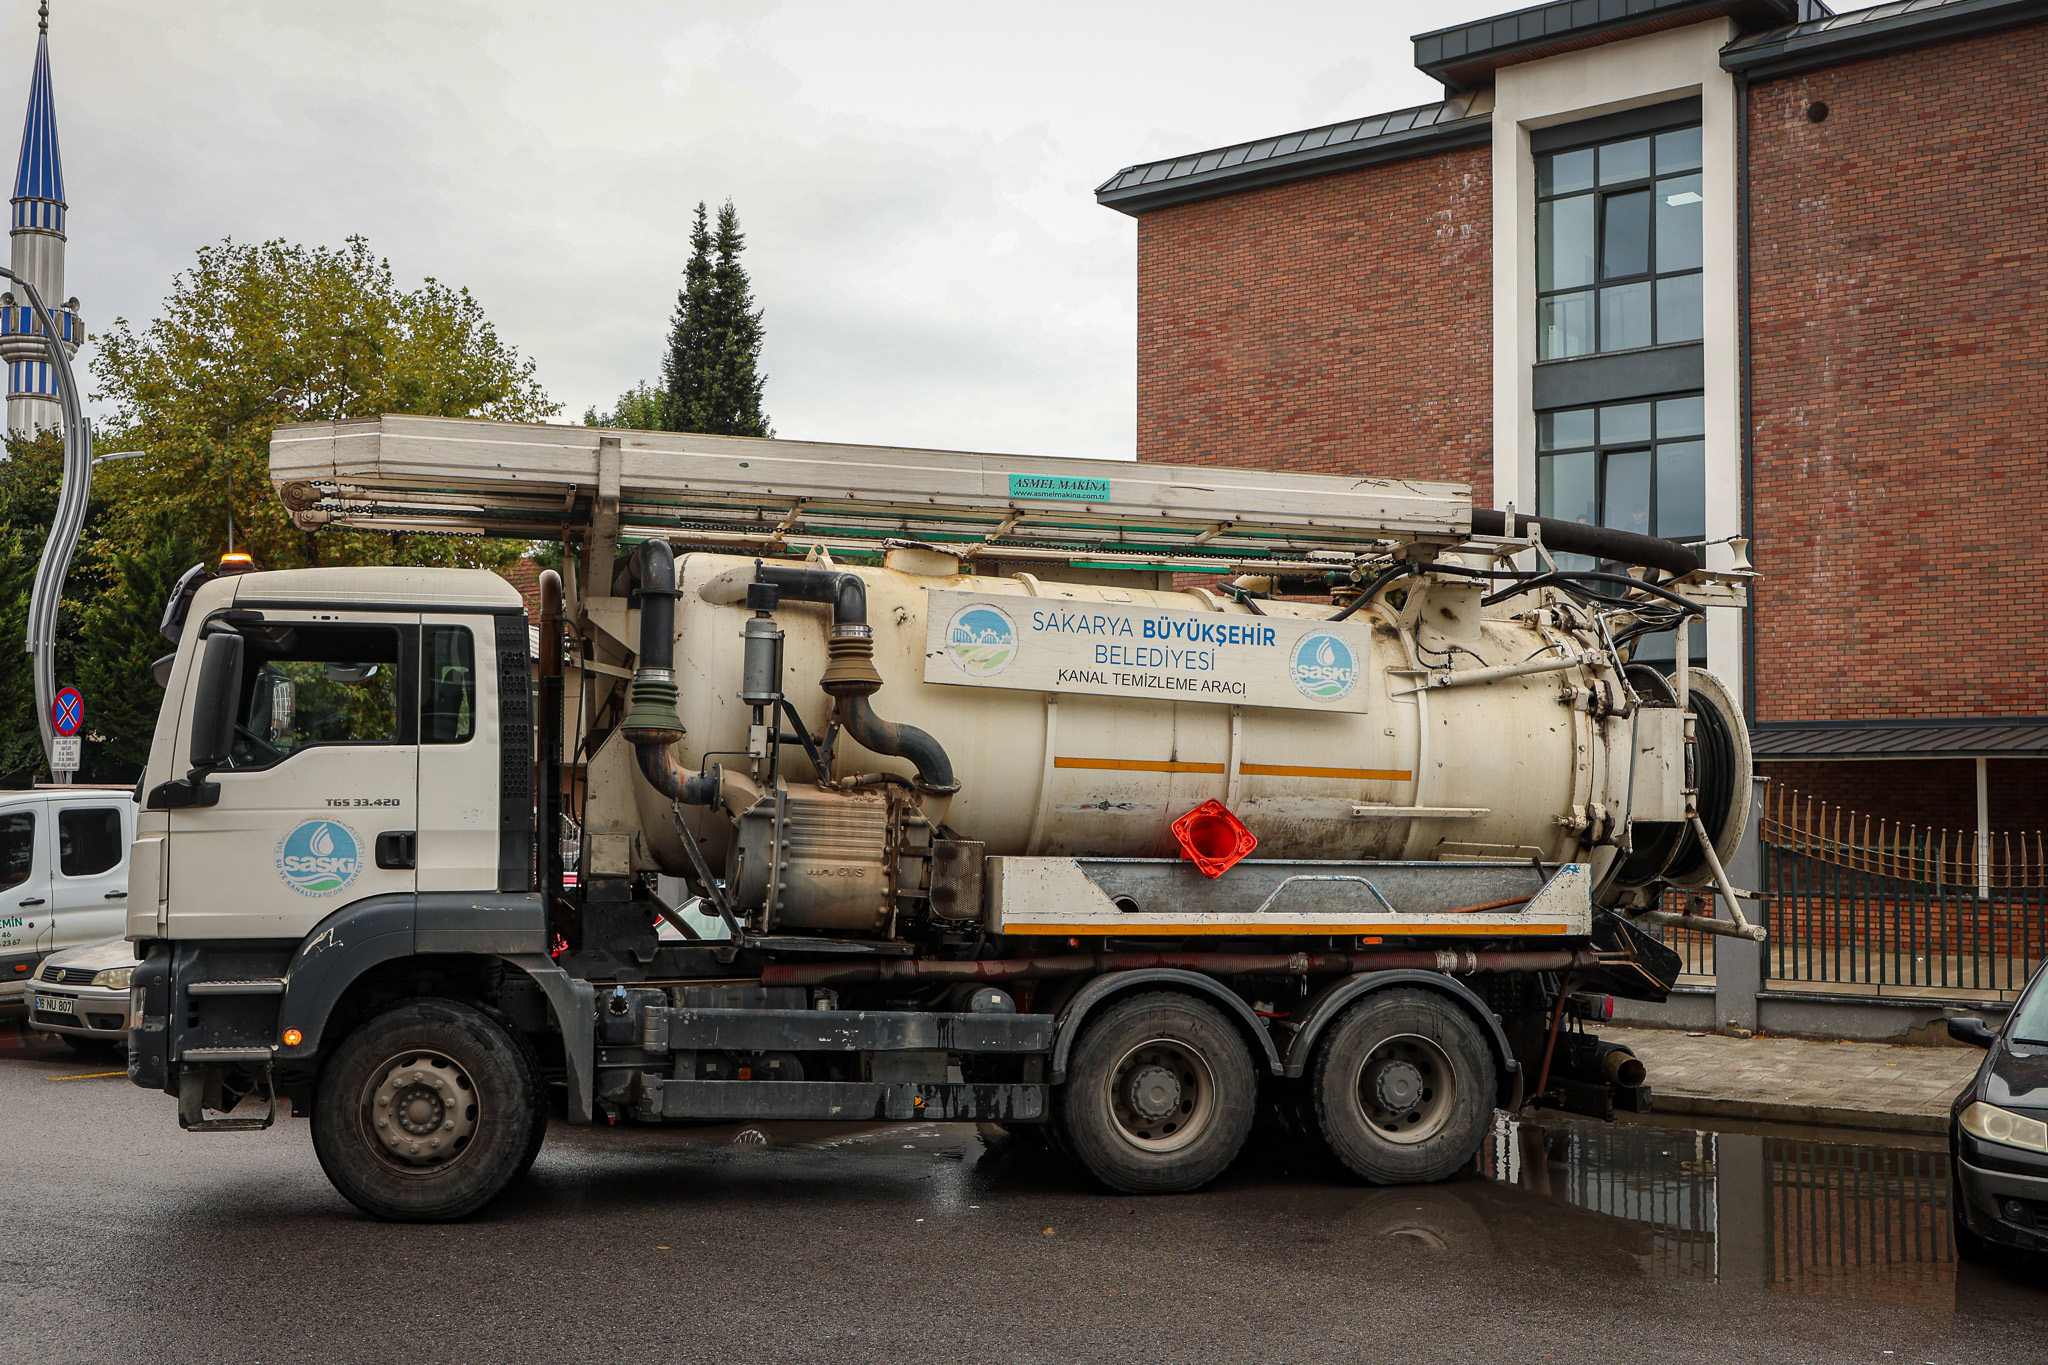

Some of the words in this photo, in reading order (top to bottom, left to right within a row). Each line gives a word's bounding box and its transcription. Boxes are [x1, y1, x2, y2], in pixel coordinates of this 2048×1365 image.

[1014, 478, 1055, 489] ASMEL
[1058, 479, 1106, 491] MAKİNA
[1013, 490, 1105, 500] www.asmelmakina.com.tr
[1032, 611, 1133, 637] SAKARYA
[1143, 616, 1276, 647] BÜYÜKŞEHİR
[1095, 644, 1215, 671] BELEDİYESİ
[1058, 669, 1108, 685] KANAL
[1112, 672, 1197, 691] TEMİZLEME
[1201, 680, 1246, 694] ARACI
[325, 798, 350, 807] TGS
[353, 798, 400, 807] 33.420
[275, 858, 283, 868] SU
[279, 870, 288, 880] VE
[343, 861, 363, 888] İDARESİ
[836, 866, 864, 877] CVS
[58, 1000, 72, 1012] 807
